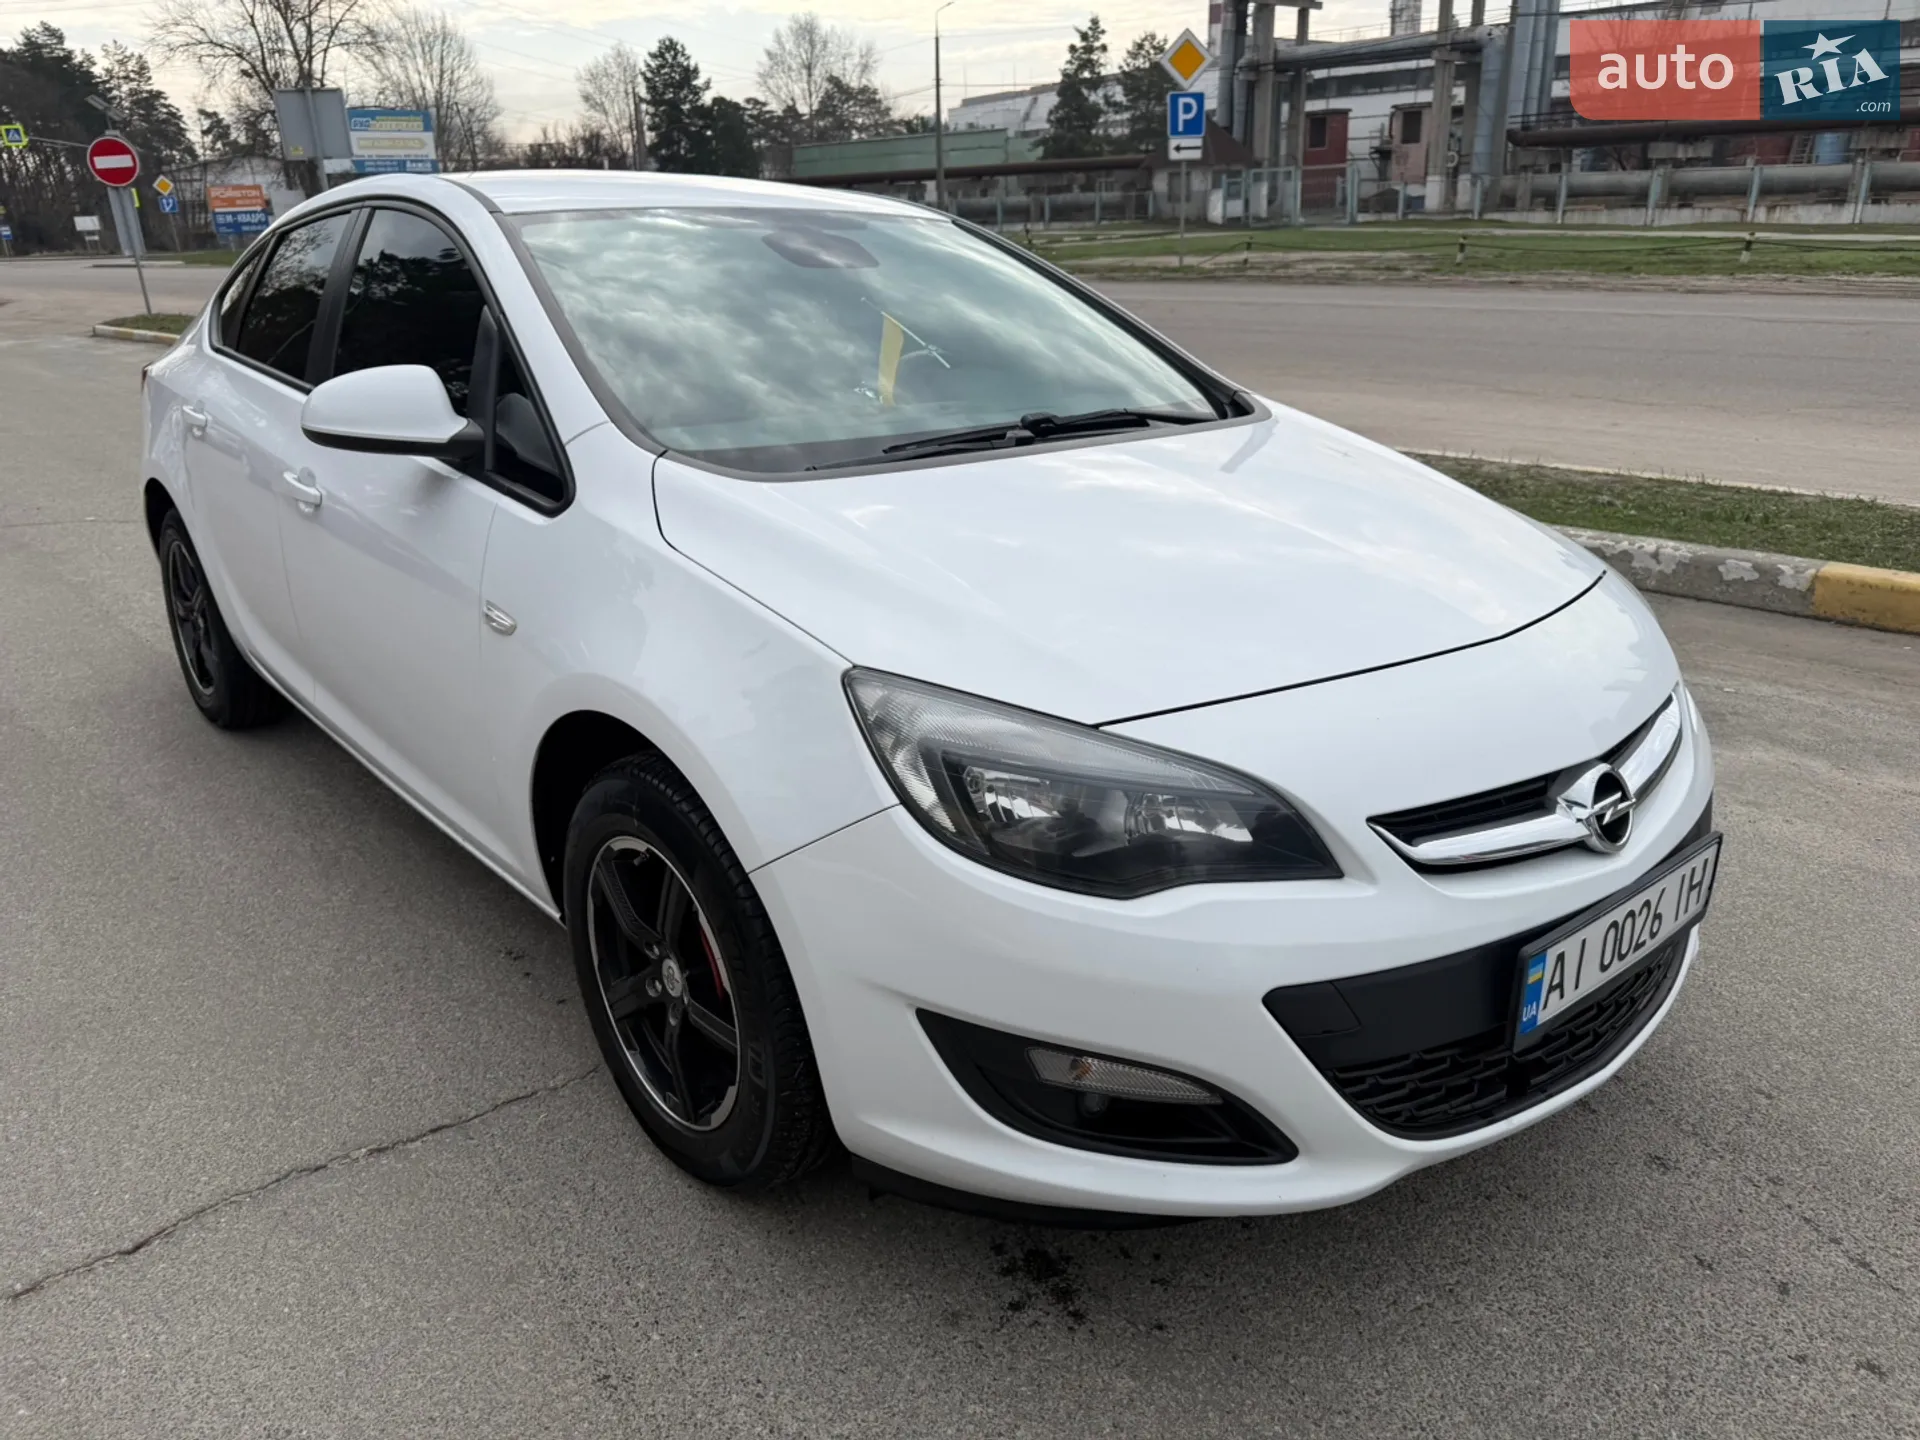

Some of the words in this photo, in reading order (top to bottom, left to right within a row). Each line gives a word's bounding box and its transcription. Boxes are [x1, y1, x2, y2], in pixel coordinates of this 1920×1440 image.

[1178, 97, 1198, 132] P
[1542, 938, 1587, 1011] AI
[1599, 886, 1666, 973] 0026
[1674, 857, 1709, 923] IH
[1522, 1004, 1537, 1022] UA
